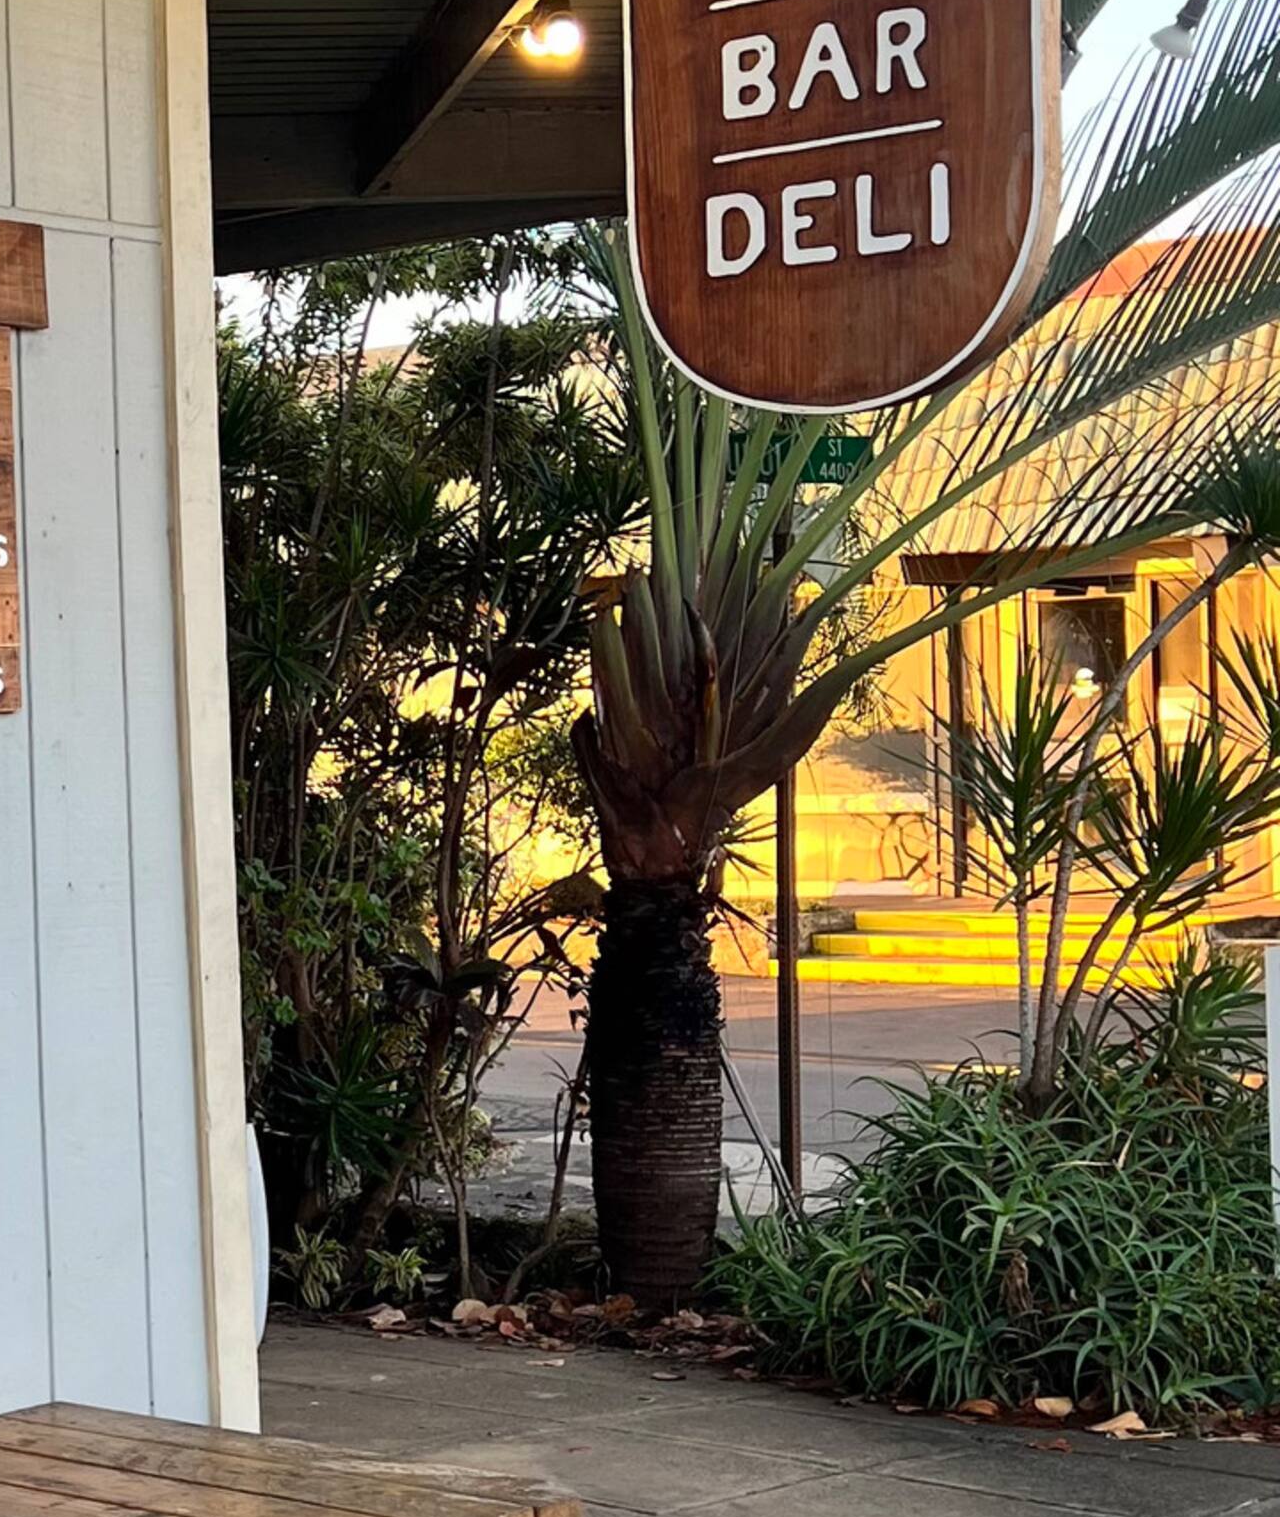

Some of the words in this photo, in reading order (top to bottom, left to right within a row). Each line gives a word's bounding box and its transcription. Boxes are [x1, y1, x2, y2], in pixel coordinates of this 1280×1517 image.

[721, 6, 927, 121] BAR
[705, 162, 951, 278] DELI
[827, 438, 843, 457] ST
